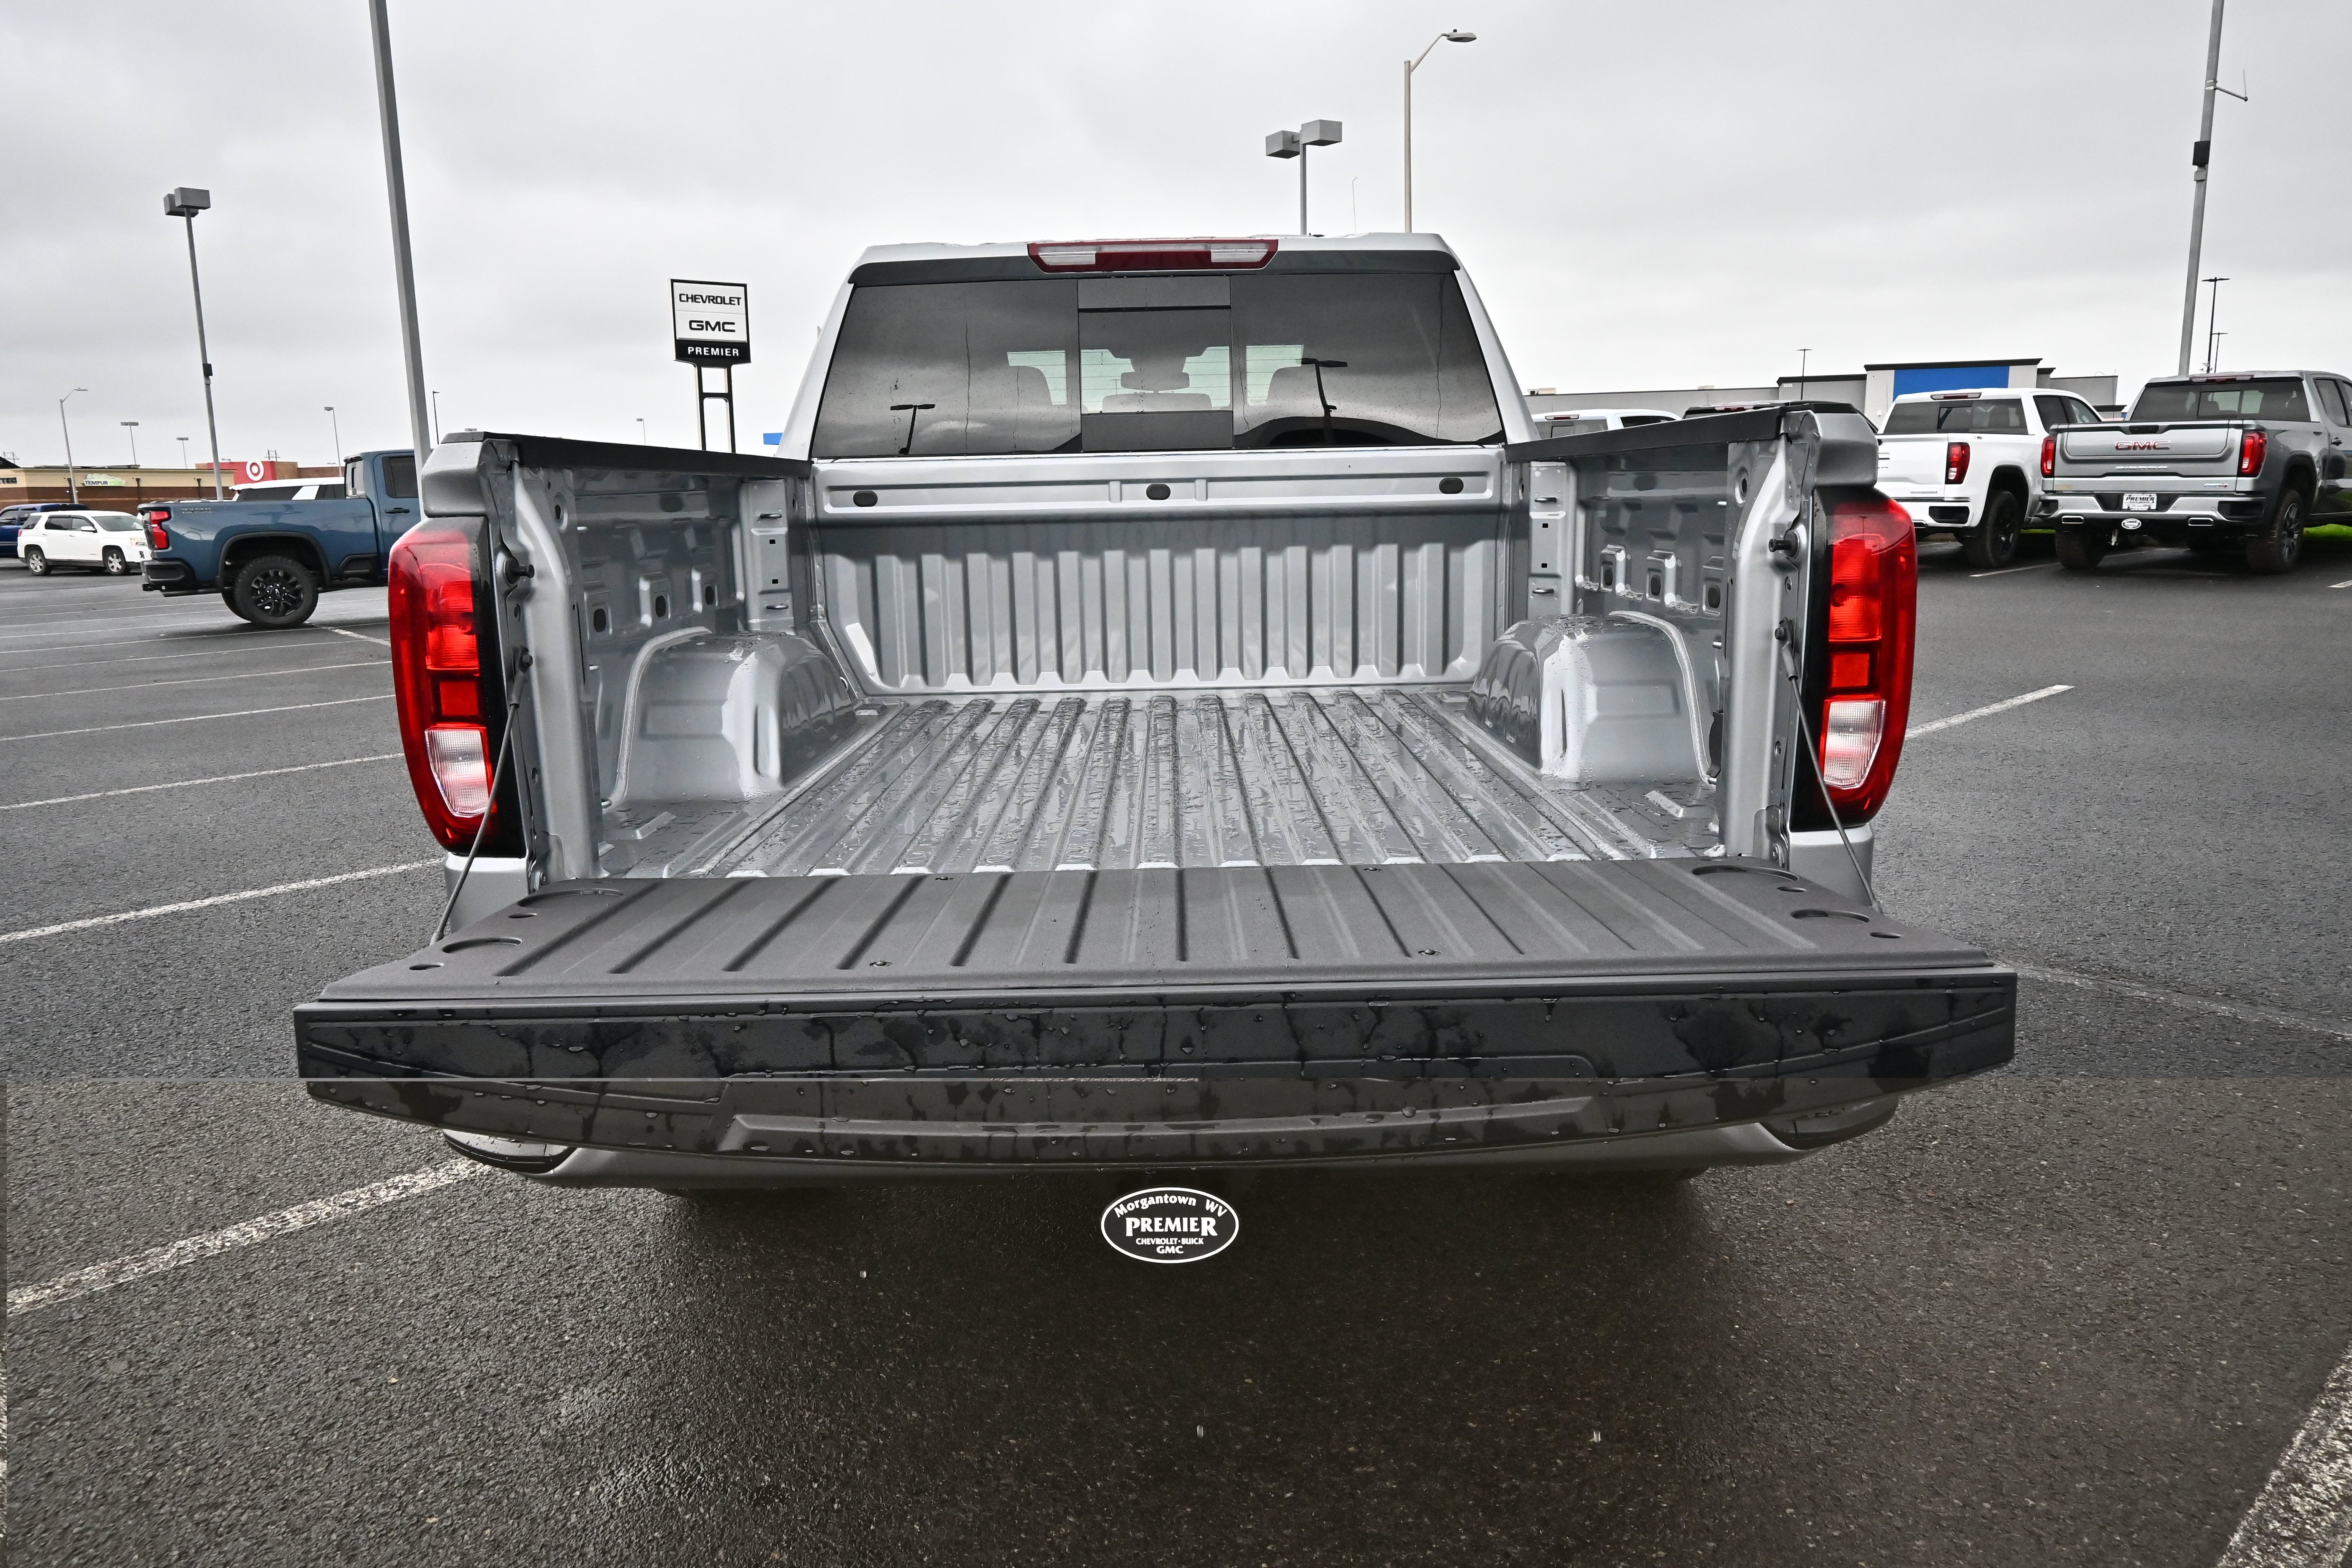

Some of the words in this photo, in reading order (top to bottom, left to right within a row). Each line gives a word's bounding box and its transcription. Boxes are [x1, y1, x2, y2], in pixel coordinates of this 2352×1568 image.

[679, 293, 742, 306] CHEVROLET
[689, 320, 735, 332] GMC
[688, 346, 739, 357] PREMIER
[2115, 441, 2170, 451] GMC
[1114, 1194, 1197, 1218] Morgantown
[1205, 1199, 1228, 1217] WV
[1125, 1217, 1218, 1236] PREMIER
[1156, 1246, 1184, 1254] GMC
